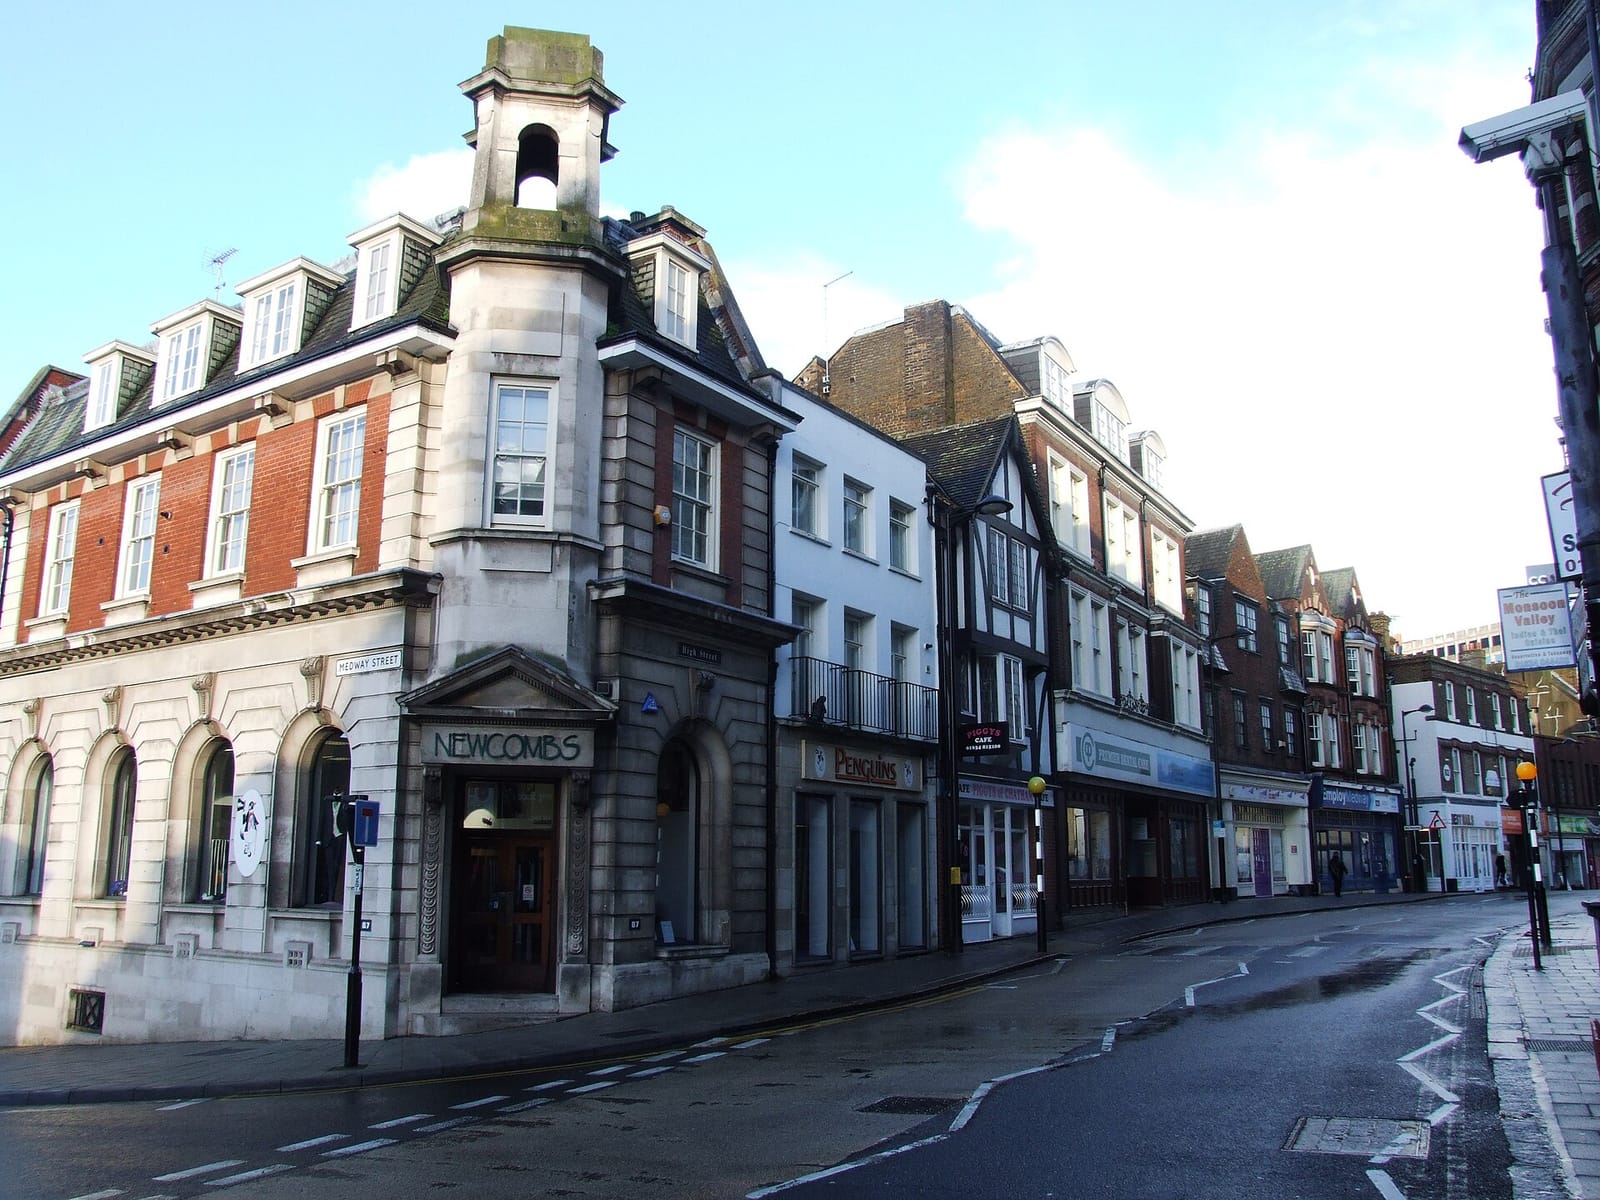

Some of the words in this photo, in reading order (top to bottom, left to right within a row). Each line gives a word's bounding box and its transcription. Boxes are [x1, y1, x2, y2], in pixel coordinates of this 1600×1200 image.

[1513, 590, 1529, 599] The
[1503, 599, 1566, 614] Monsoon
[1514, 614, 1555, 627] Valley
[699, 650, 718, 662] Street
[339, 658, 370, 673] MEDWAY
[372, 653, 399, 669] STREET
[966, 727, 1001, 739] PIGGYS
[974, 736, 993, 744] CAFE
[434, 731, 582, 762] NEWCOMBS
[959, 783, 971, 793] AFE
